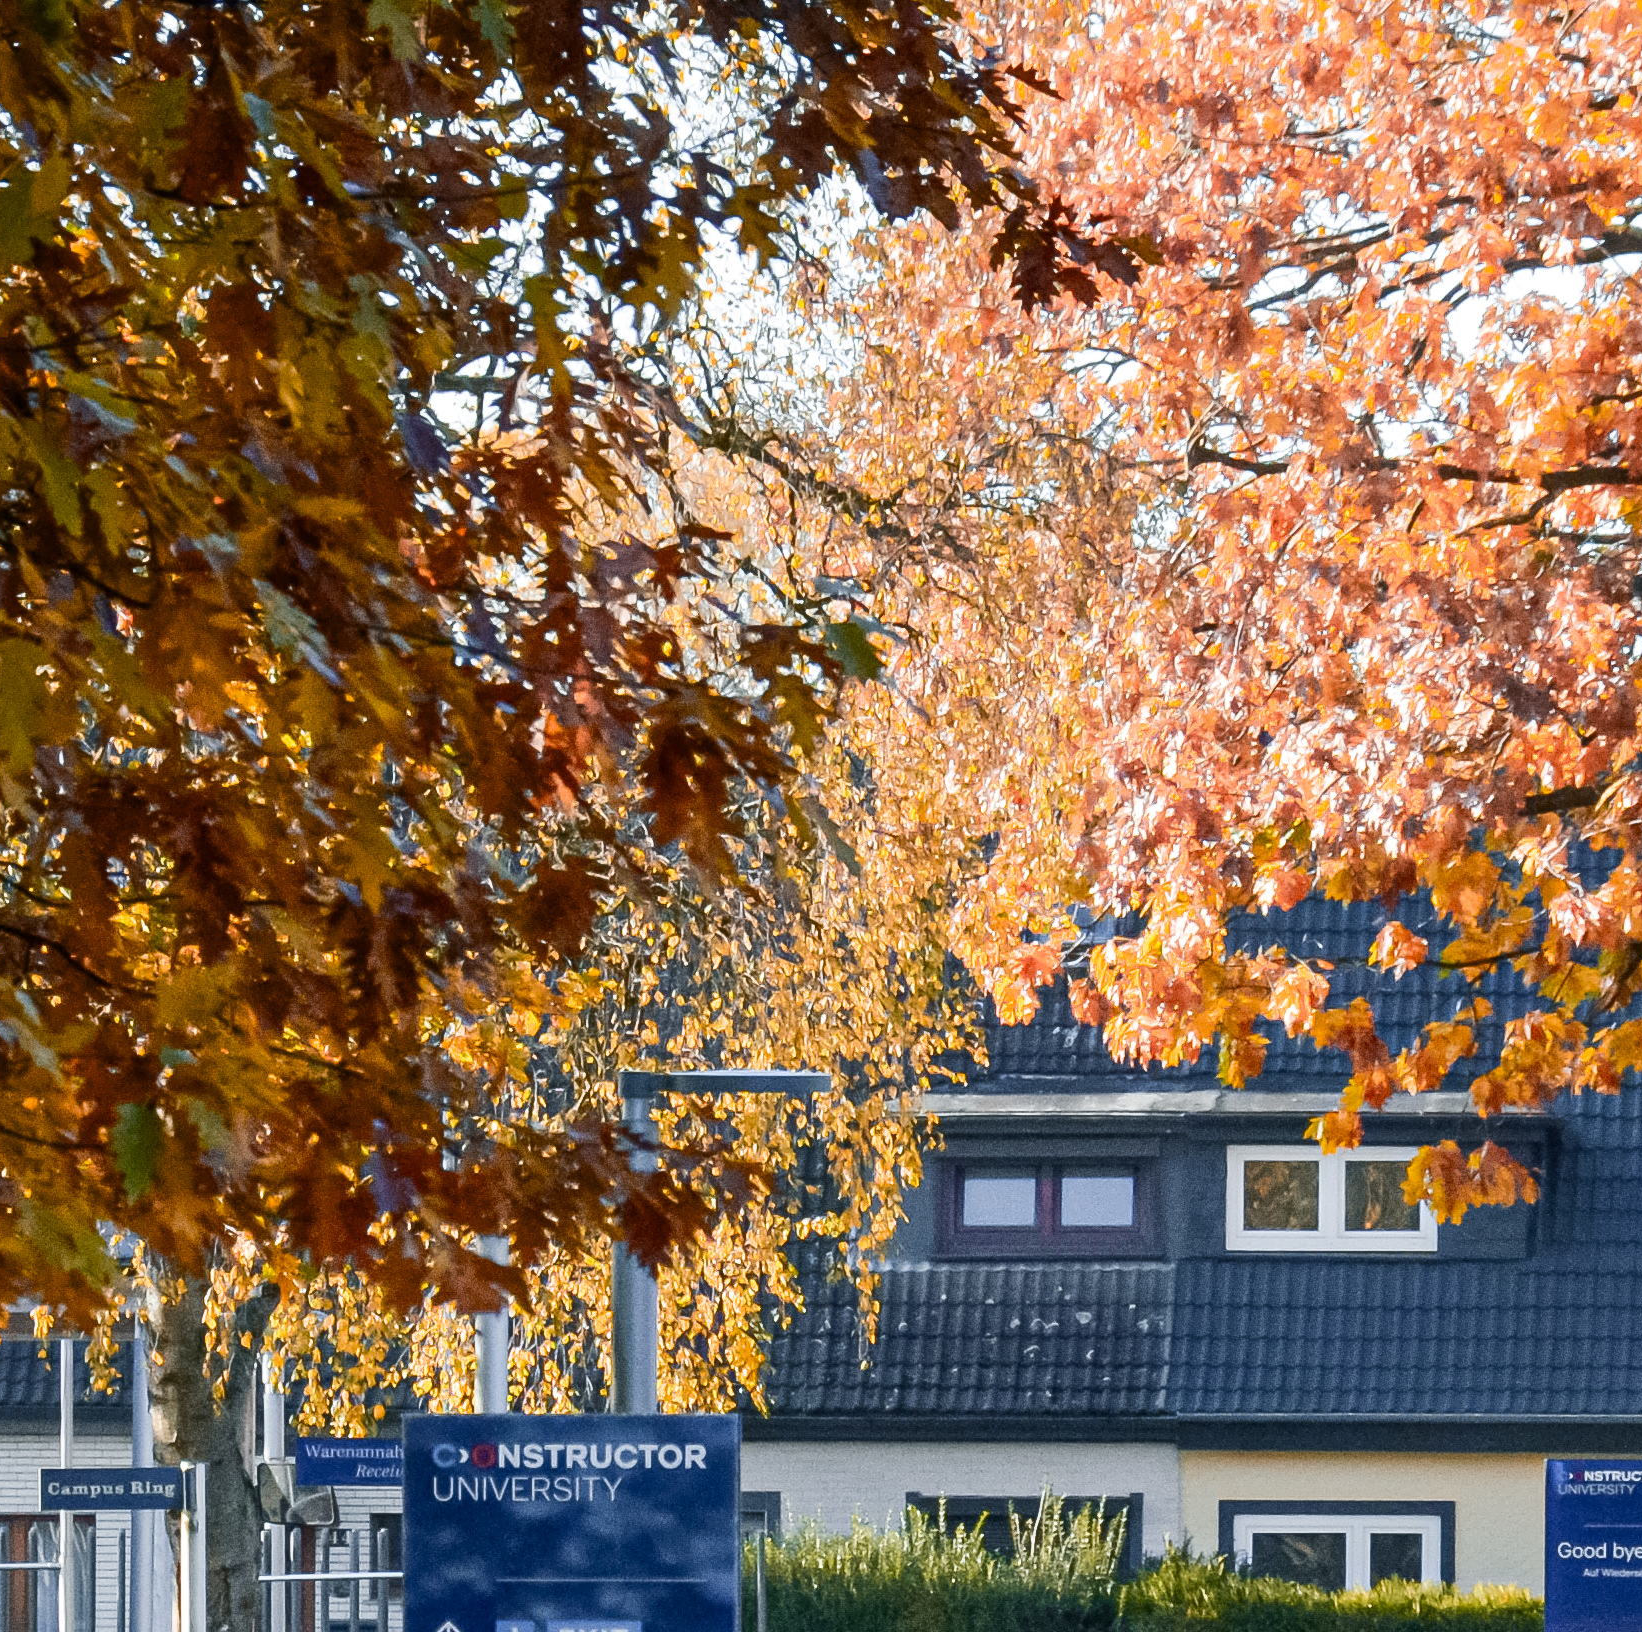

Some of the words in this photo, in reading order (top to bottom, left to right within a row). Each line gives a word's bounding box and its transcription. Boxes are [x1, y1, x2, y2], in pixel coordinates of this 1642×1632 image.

[47, 1482, 124, 1498] Campus
[130, 1481, 176, 1498] Ring
[433, 1476, 623, 1502] UNIVERSITY
[1557, 1484, 1636, 1495] UNIVERSITY
[1557, 1542, 1607, 1559] Good
[1583, 1568, 1599, 1578] Auf
